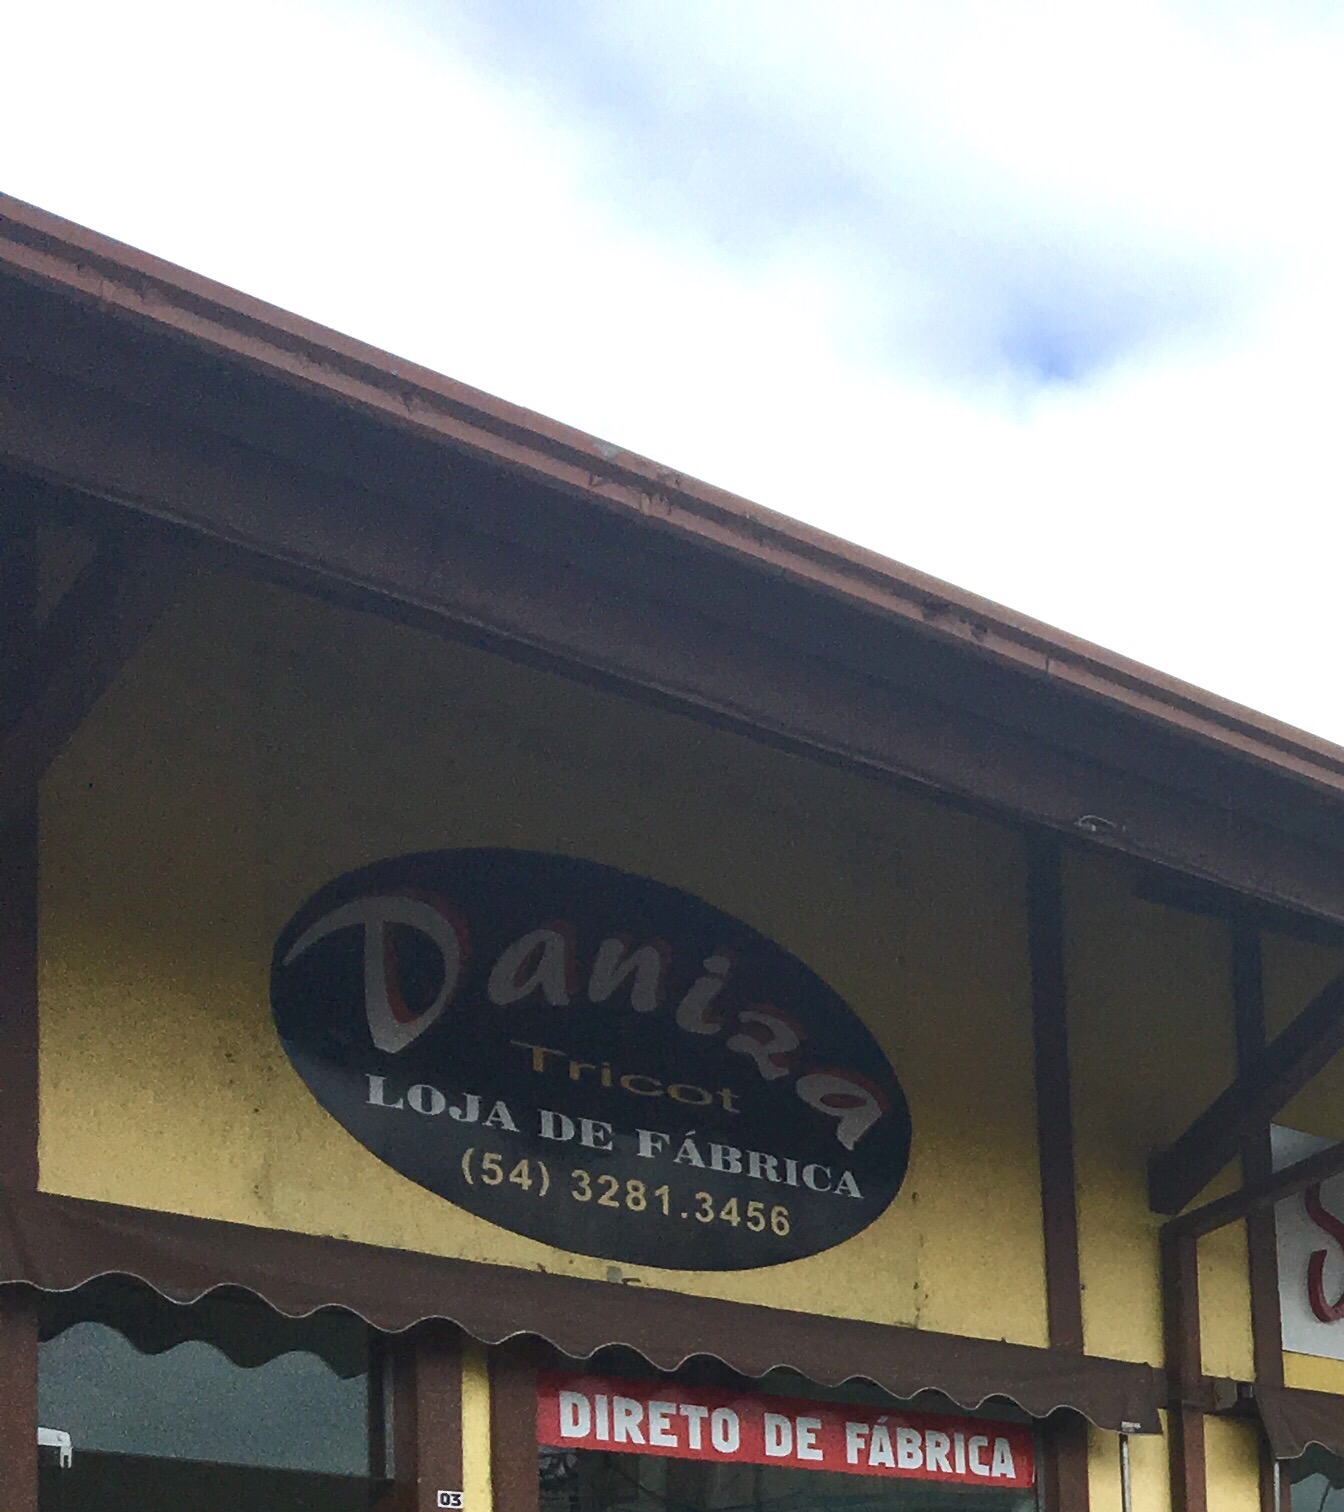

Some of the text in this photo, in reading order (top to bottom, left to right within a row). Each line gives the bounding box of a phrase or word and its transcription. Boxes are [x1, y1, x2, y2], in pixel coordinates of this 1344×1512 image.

[283, 893, 887, 1152] Daniza
[509, 1040, 742, 1114] Tricot
[364, 1073, 865, 1201] LOJA DE FÁBRICA
[460, 1147, 791, 1238] (54) 3281.3456
[558, 1389, 1017, 1480] DIRETO DE FÁBRICA
[440, 1492, 462, 1507] 03
